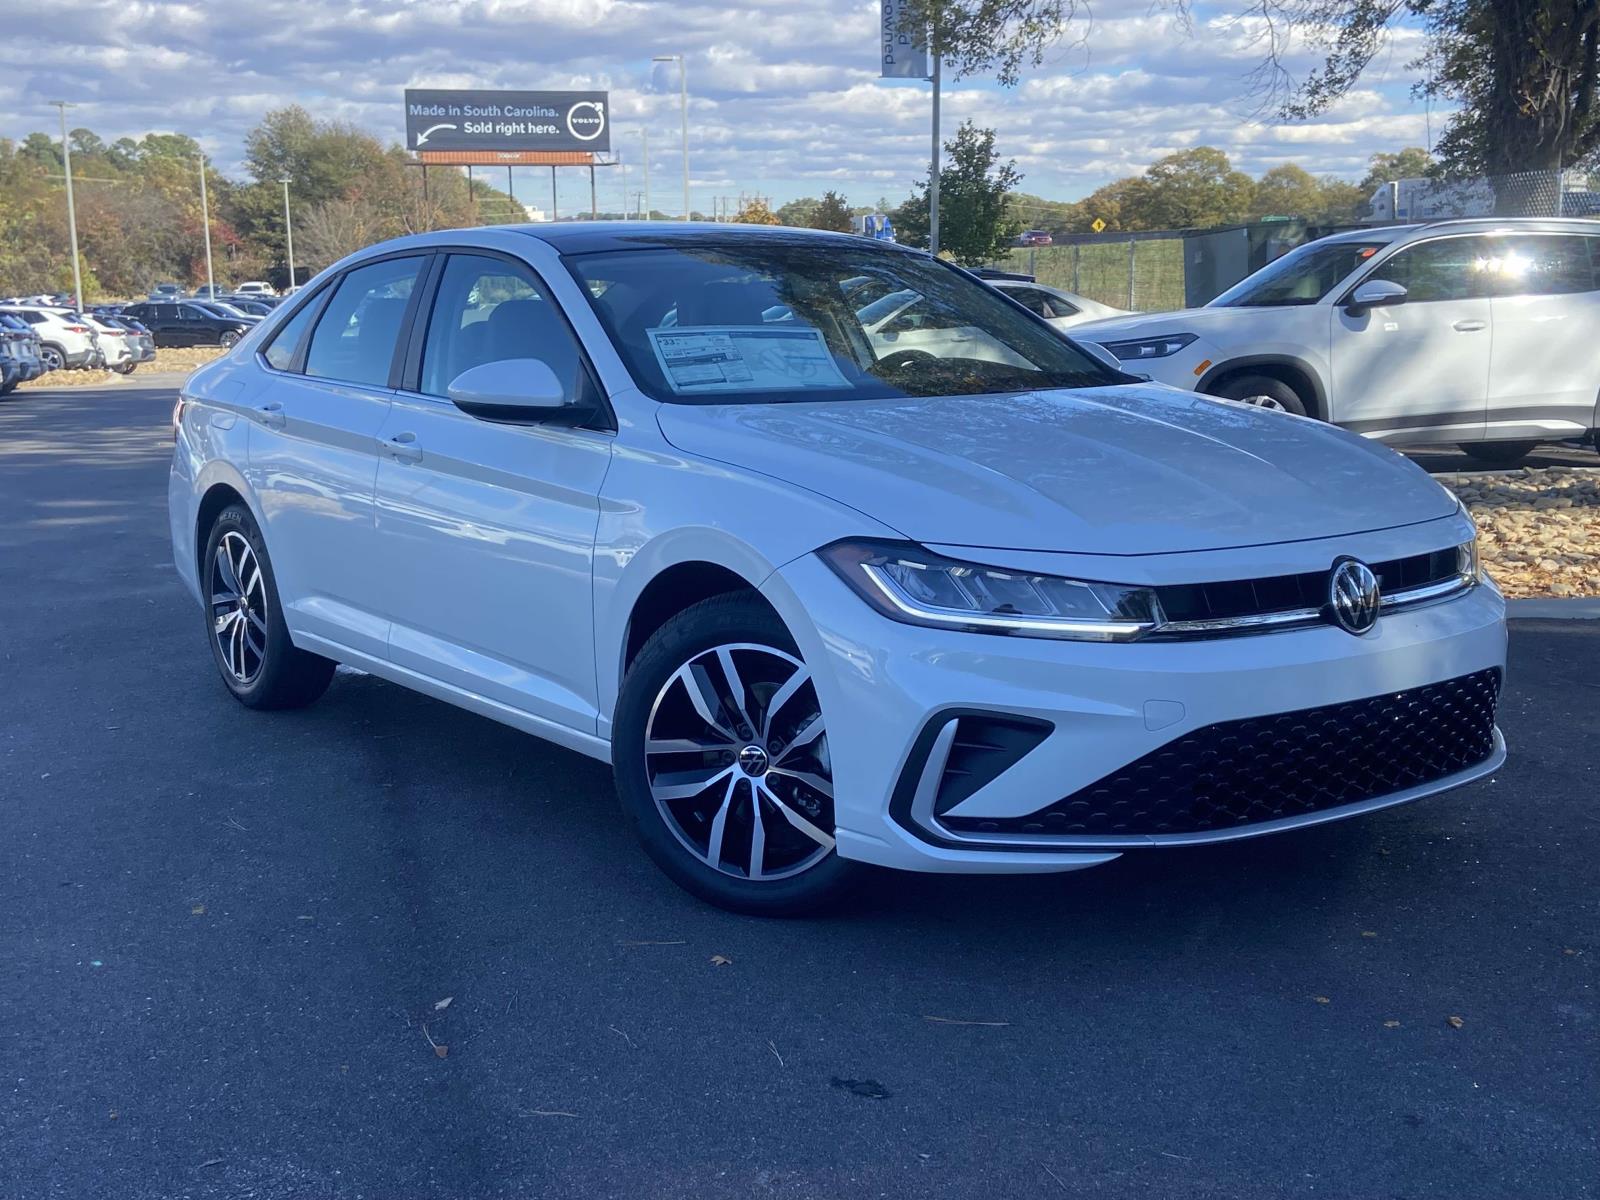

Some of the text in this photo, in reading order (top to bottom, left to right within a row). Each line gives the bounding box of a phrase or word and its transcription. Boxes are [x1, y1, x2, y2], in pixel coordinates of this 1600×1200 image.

[409, 104, 560, 117] Made in South Carolina.
[464, 121, 560, 136] Sold right here.
